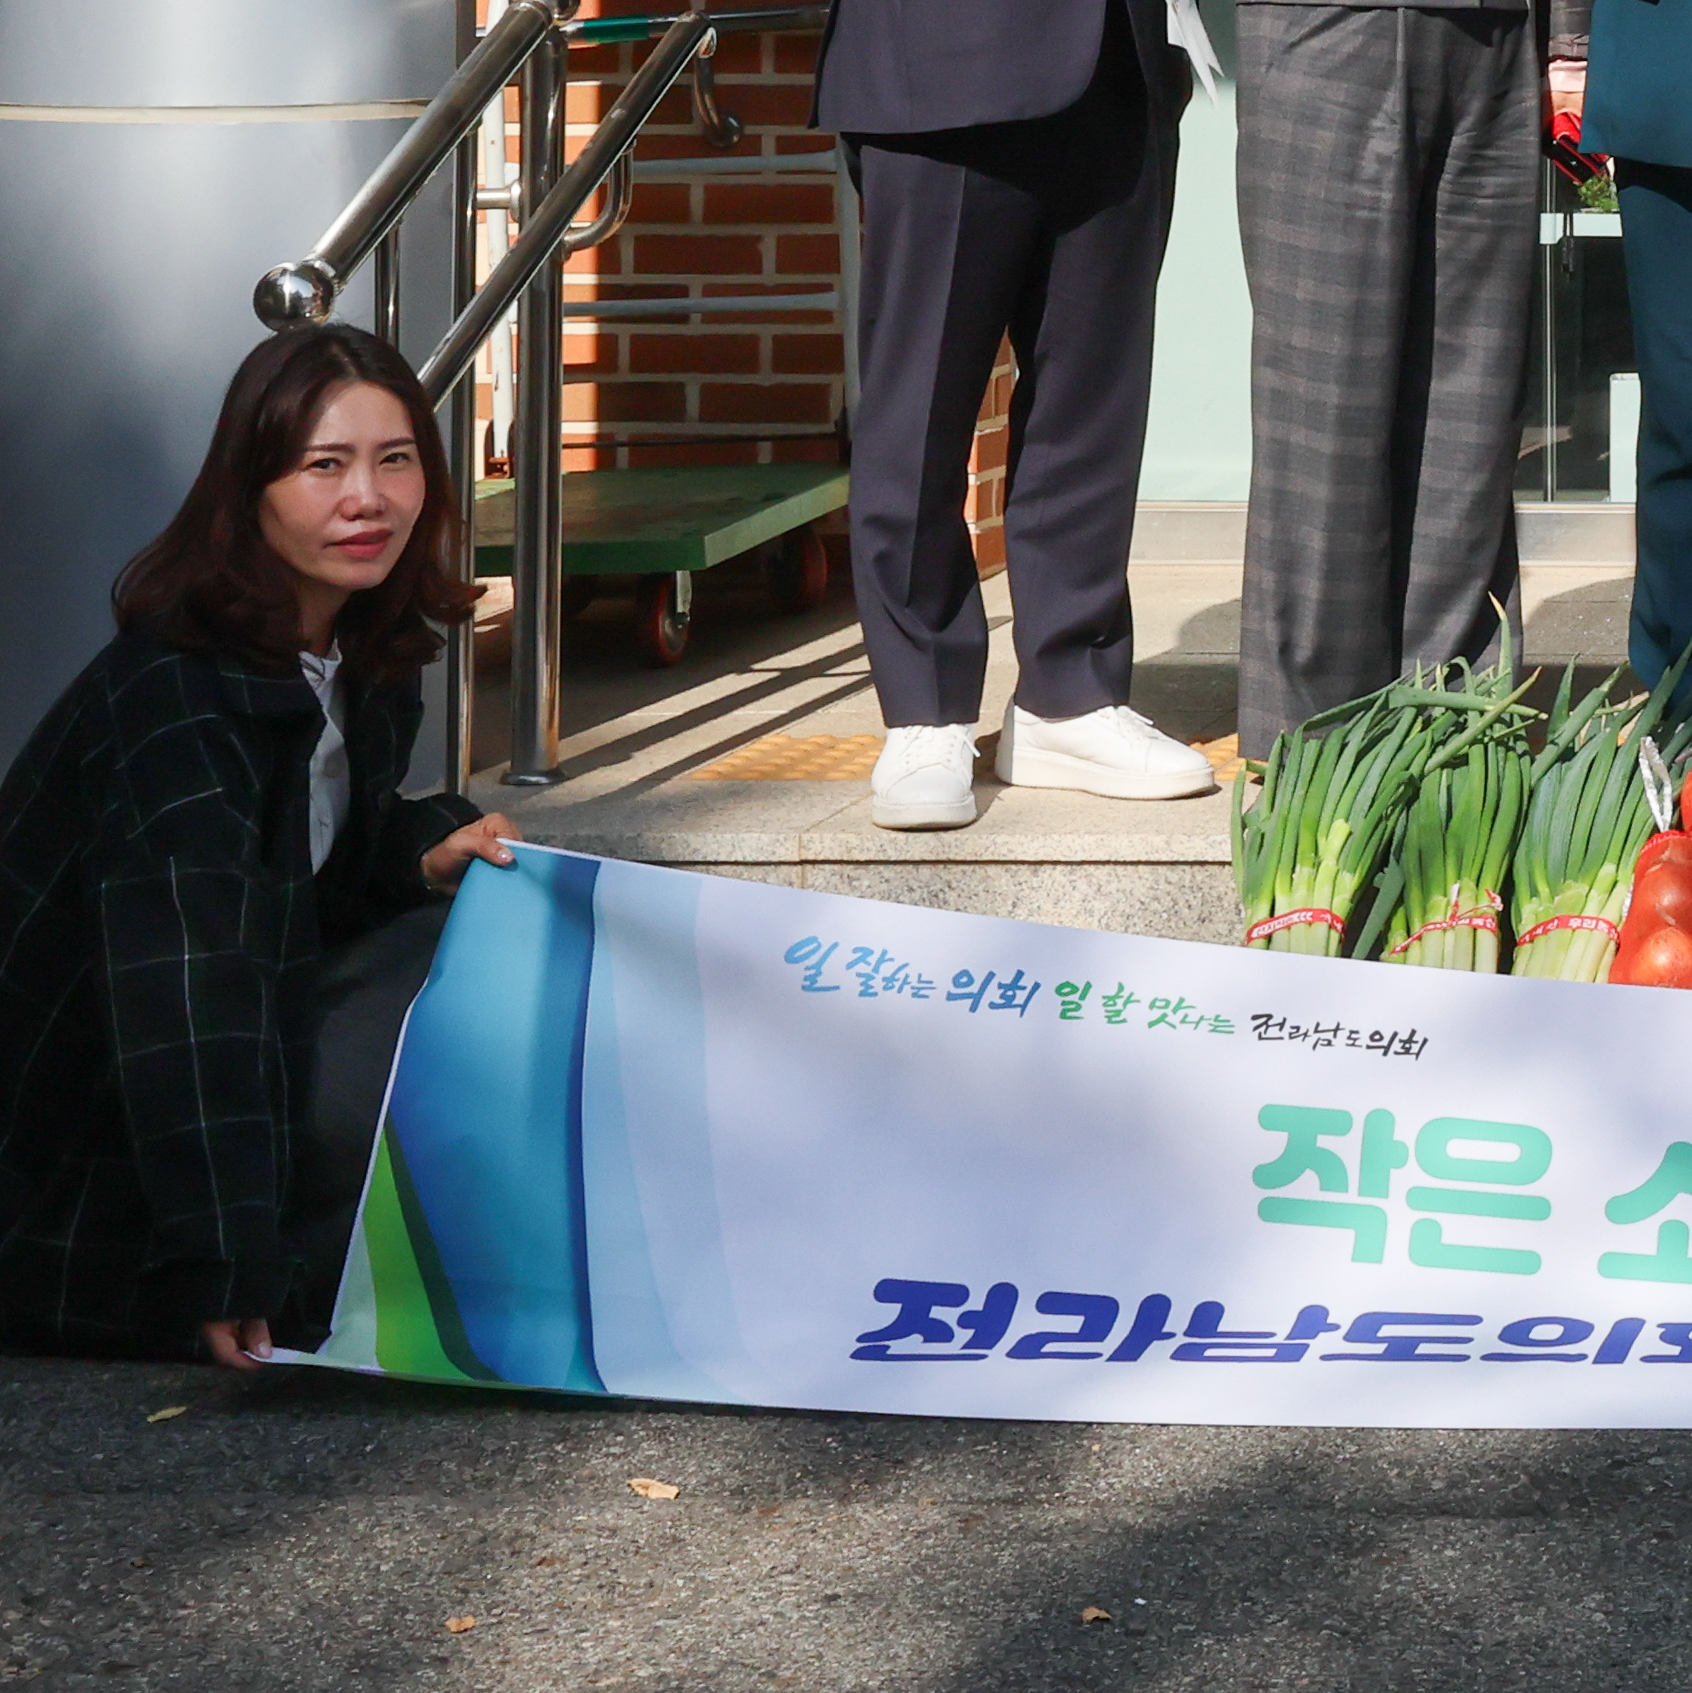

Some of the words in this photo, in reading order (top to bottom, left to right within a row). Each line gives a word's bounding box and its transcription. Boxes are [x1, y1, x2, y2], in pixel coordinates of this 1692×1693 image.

[784, 934, 841, 993] 일
[945, 968, 1041, 1017] 의회
[1250, 1012, 1430, 1062] 전라남도의회
[1252, 1104, 1552, 1275] 작은
